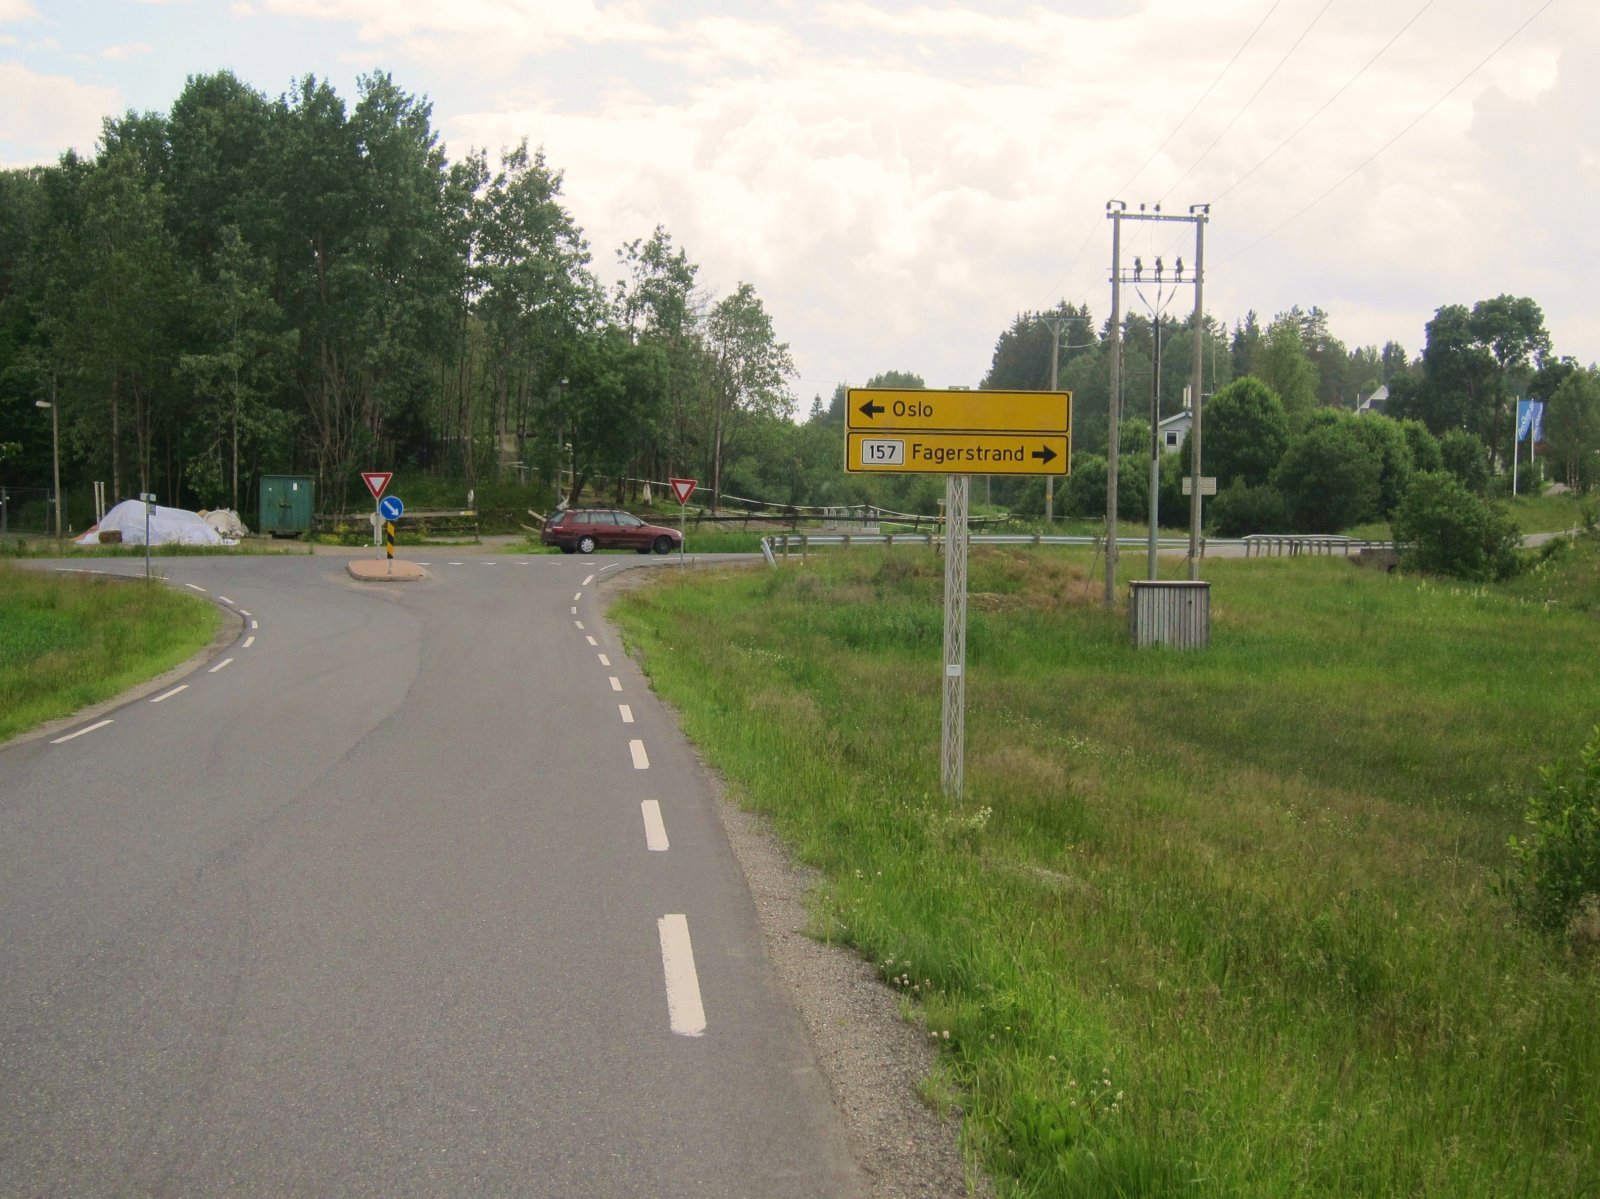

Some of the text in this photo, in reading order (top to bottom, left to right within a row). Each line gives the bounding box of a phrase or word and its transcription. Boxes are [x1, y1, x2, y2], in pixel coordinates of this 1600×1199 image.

[893, 400, 933, 417] Oslo
[869, 443, 1024, 464] 157 Fagerstrand
